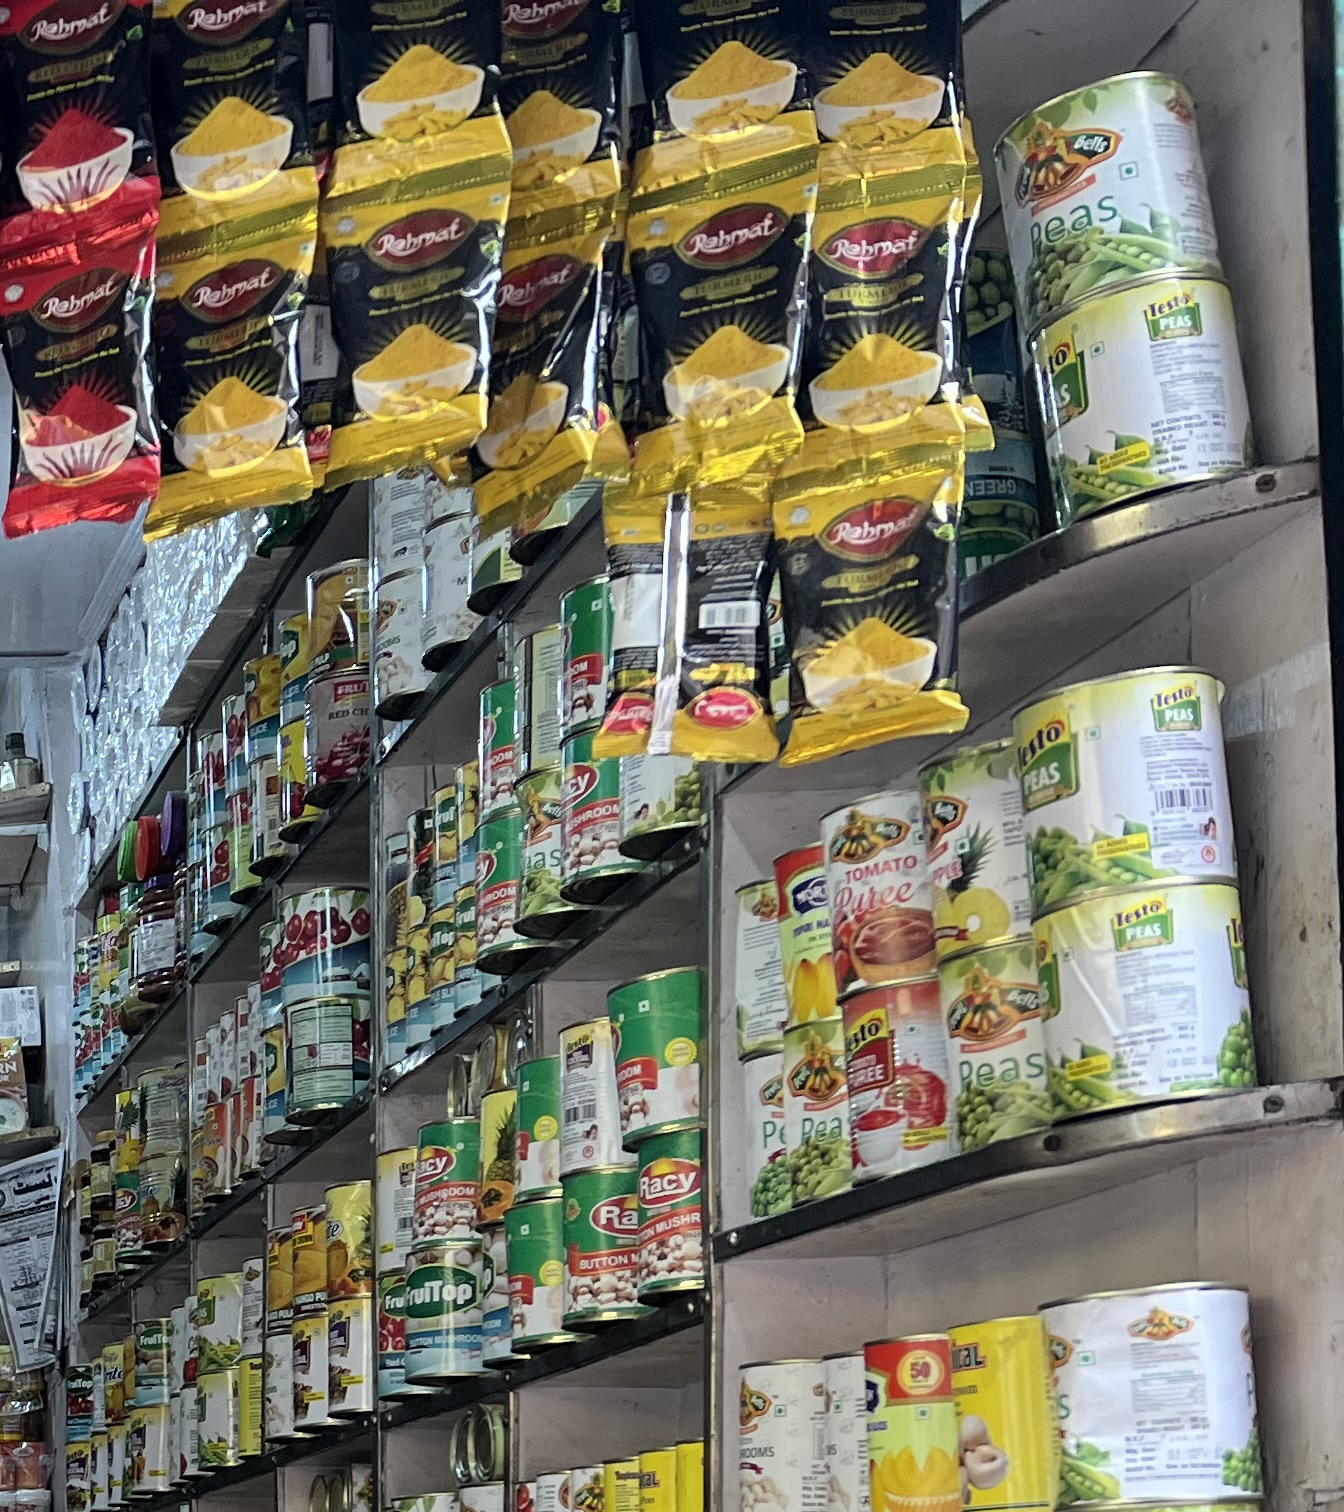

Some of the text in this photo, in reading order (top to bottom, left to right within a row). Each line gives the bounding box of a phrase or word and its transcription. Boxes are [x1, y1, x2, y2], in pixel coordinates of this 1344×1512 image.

[31, 4, 110, 43] Rehmat
[188, 0, 270, 34] Rehmat
[1073, 135, 1107, 152] Bells
[375, 217, 465, 257] Rehmat
[688, 212, 779, 254] Rehmat
[1030, 195, 1118, 257] Peas
[831, 230, 918, 261] Rehmat
[43, 277, 117, 317] Rehmat
[193, 260, 280, 308] Rehmat
[1147, 292, 1191, 318] Testo
[1160, 314, 1192, 332] PEAS
[831, 501, 918, 545] Rehmat
[1155, 686, 1193, 707] Testo
[1164, 707, 1193, 722] PEAS
[1023, 762, 1062, 794] PEAS
[845, 855, 917, 882] TOMATO
[833, 882, 913, 917] Puree
[1115, 903, 1161, 927] Testo
[1126, 924, 1162, 940] PEAS
[959, 1052, 1047, 1089] Peas
[641, 1173, 697, 1197] Racy
[580, 1254, 628, 1270] BUTTON
[909, 1359, 930, 1380] 50
